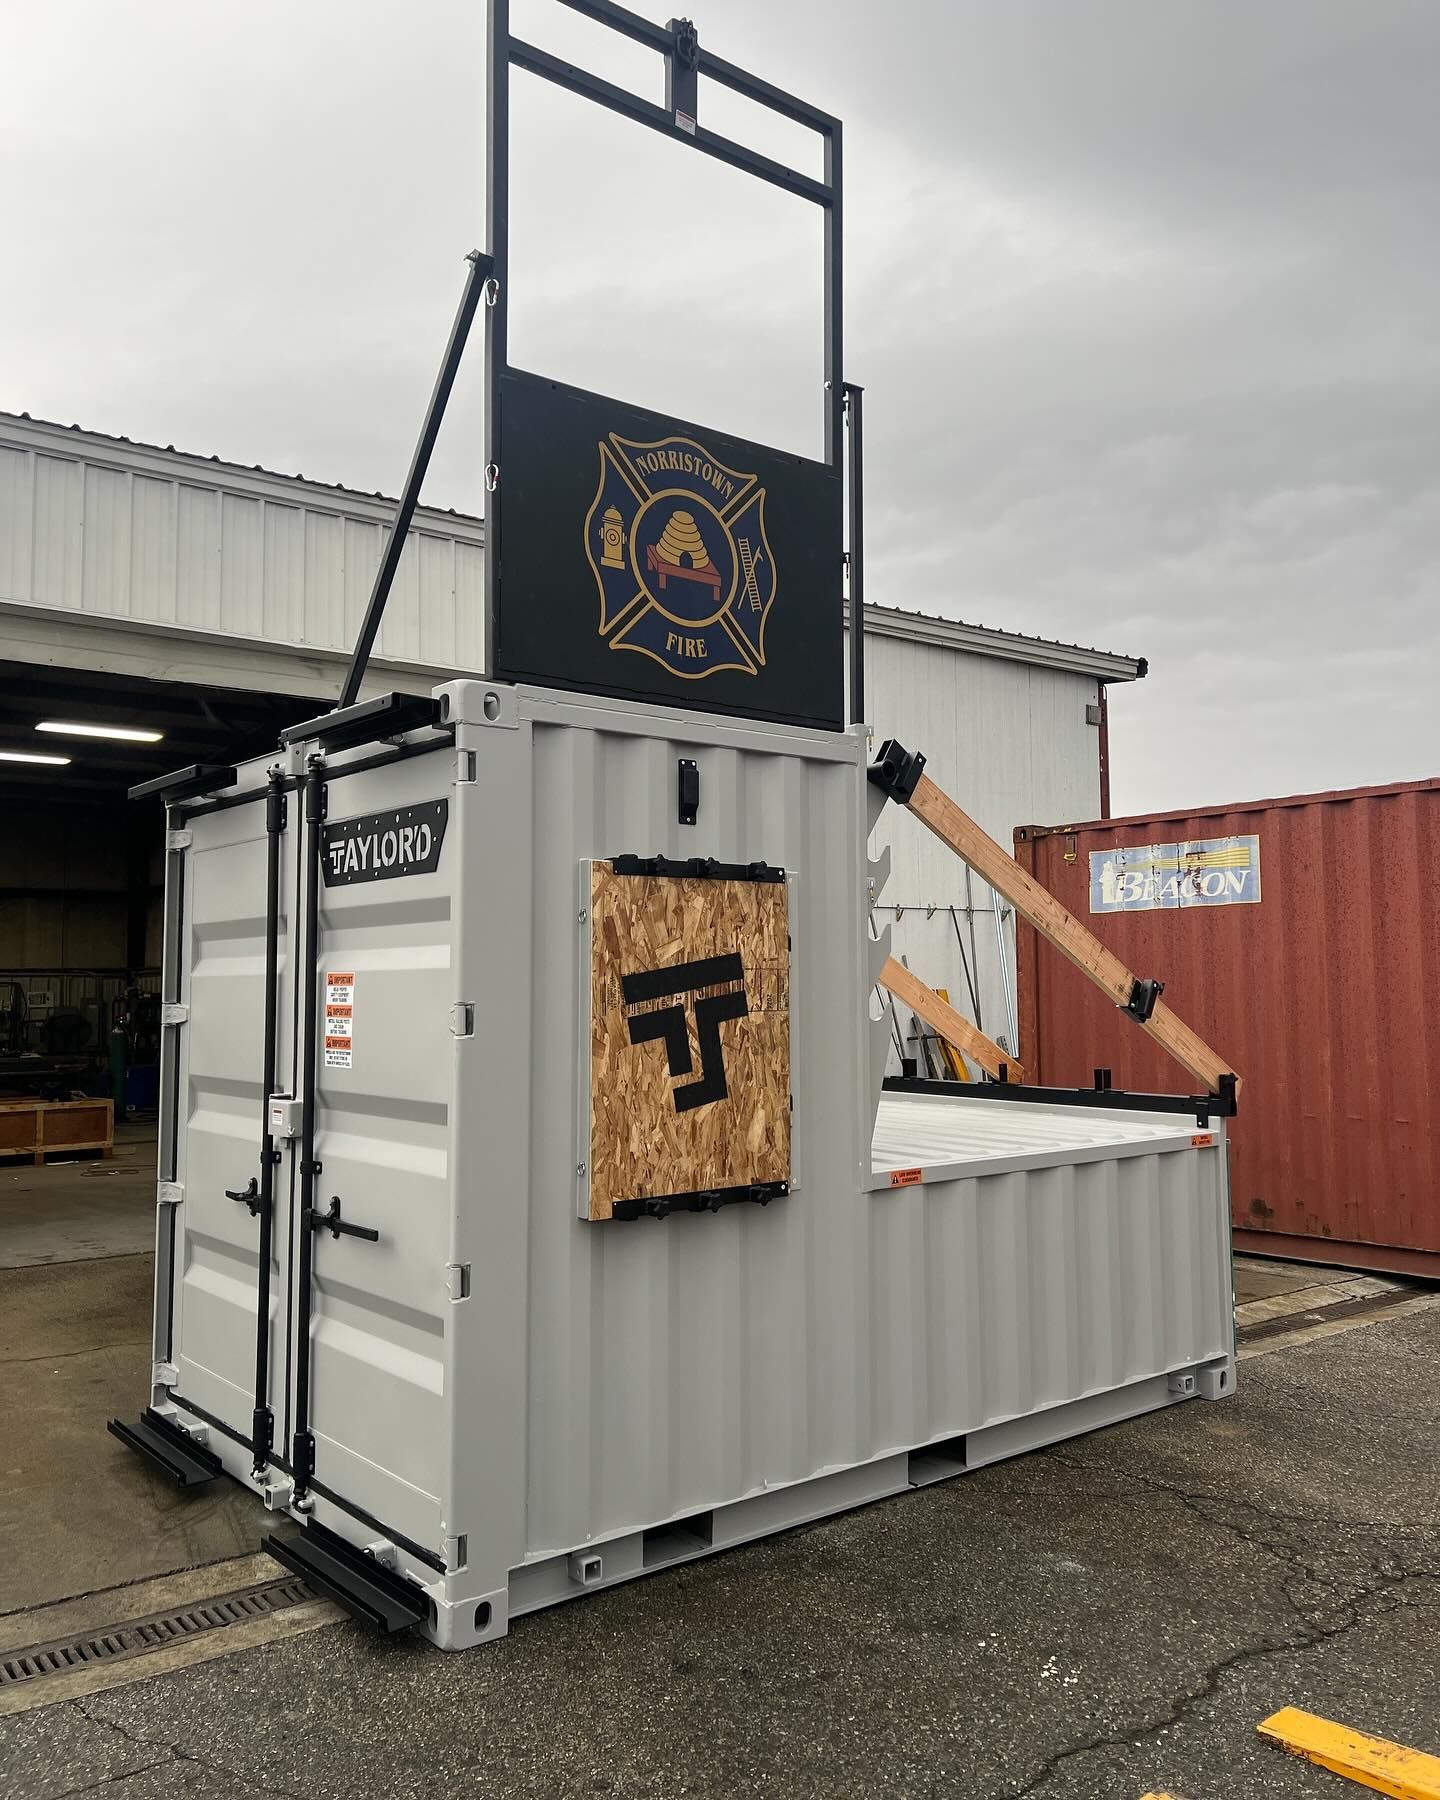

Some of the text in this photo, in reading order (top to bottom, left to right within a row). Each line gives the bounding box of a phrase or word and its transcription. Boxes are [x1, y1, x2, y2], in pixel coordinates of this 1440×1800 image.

[635, 450, 735, 500] NORRISTOWN
[666, 632, 709, 658] FIRE
[1117, 869, 1251, 902] BEACON
[332, 1007, 352, 1016] IMPORTANT
[331, 1039, 351, 1048] IMPORTANT
